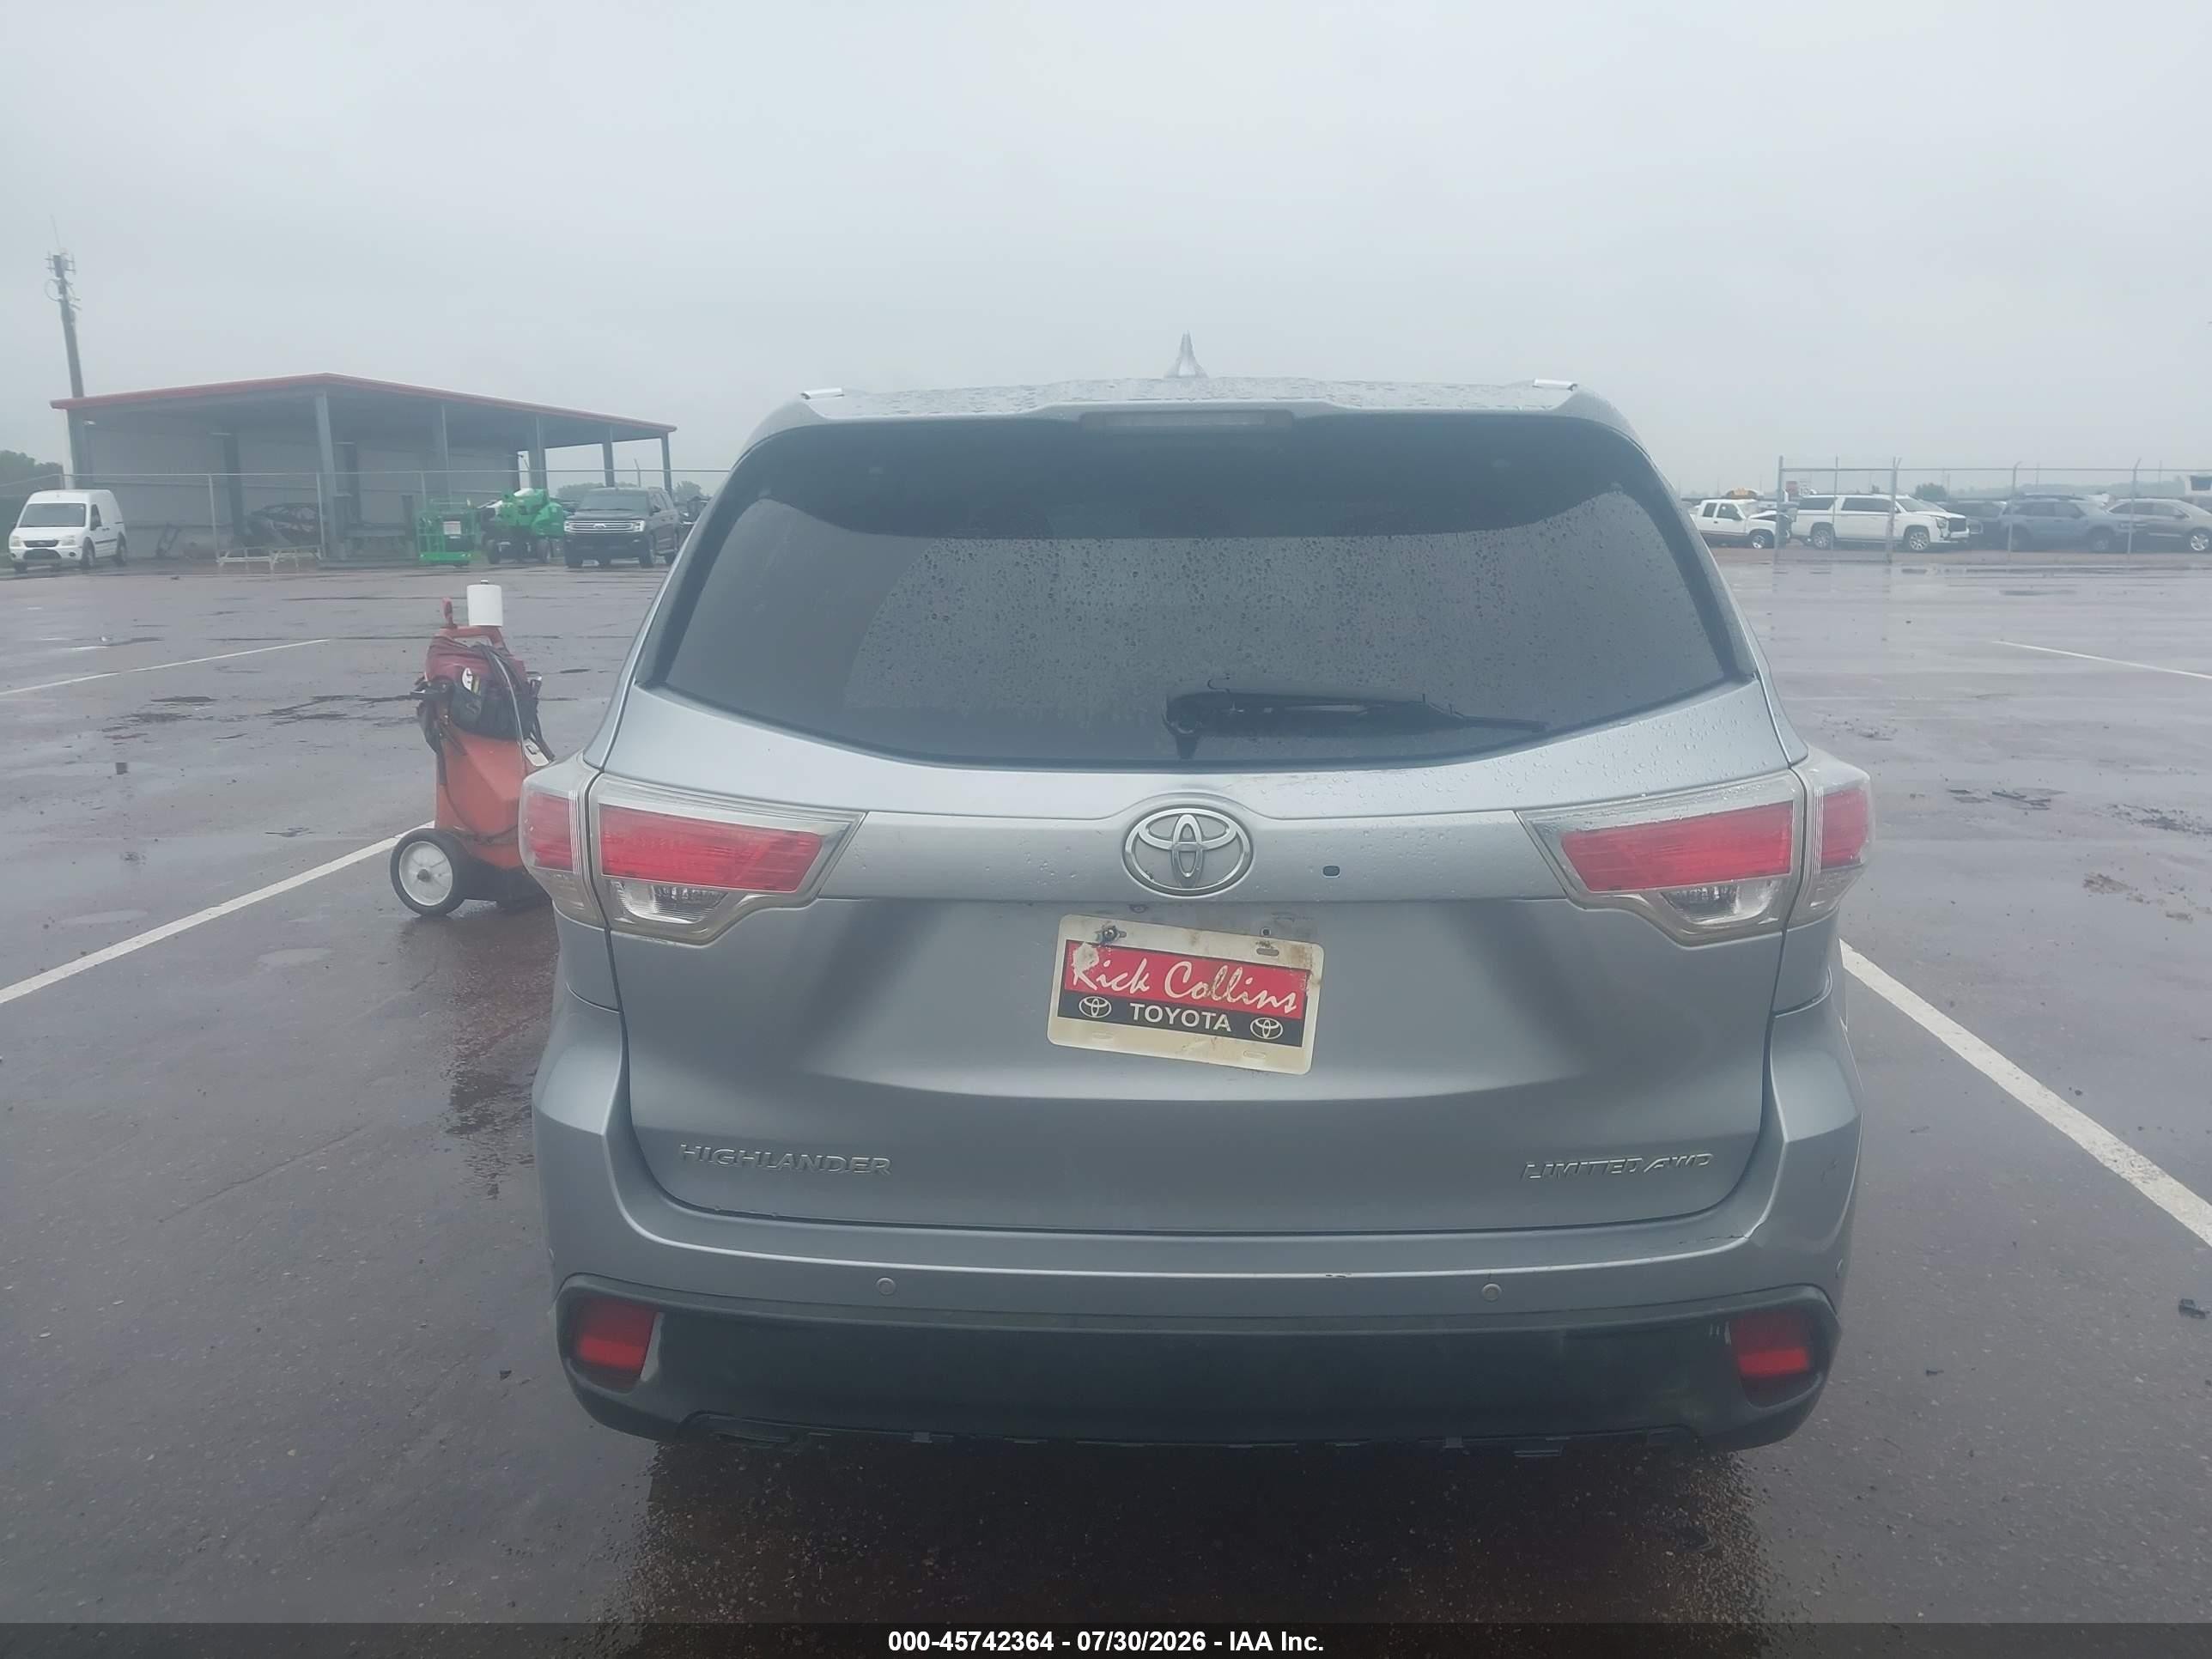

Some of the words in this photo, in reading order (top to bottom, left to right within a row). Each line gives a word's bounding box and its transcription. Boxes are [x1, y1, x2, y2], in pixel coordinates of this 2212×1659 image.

[1071, 943, 1151, 994] Rick
[1164, 961, 1298, 1013] Collins
[1129, 1002, 1232, 1032] TOYOTA
[679, 1143, 892, 1176] HIGHLANDER
[1520, 1157, 1644, 1181] LIMITED
[1644, 1152, 1714, 1175] AWD
